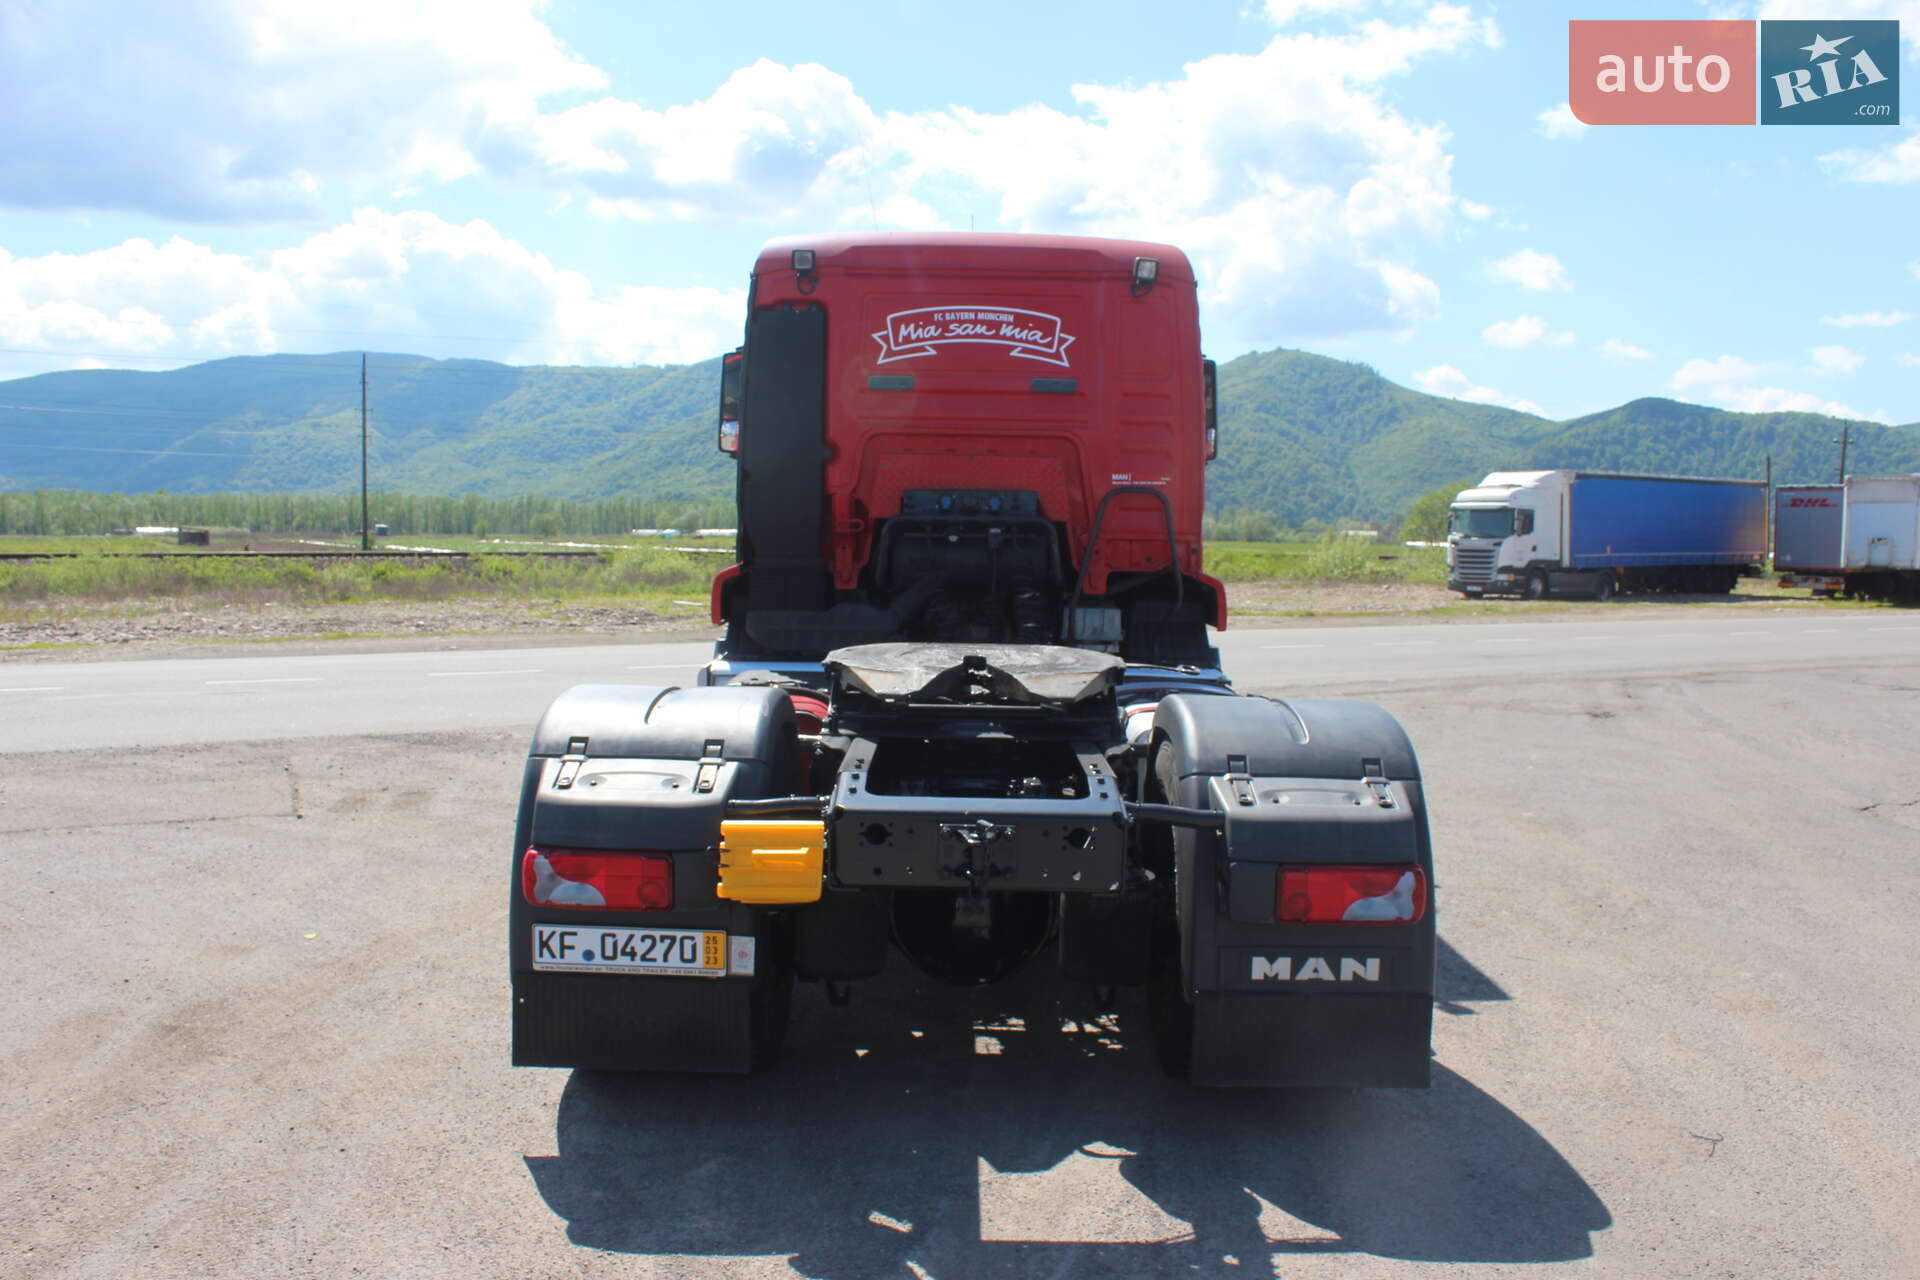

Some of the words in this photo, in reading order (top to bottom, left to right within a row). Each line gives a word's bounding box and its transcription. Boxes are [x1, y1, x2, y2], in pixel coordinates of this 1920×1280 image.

[934, 313, 943, 321] FC
[945, 312, 975, 321] BAYERN
[899, 322, 942, 343] Mia
[944, 322, 996, 336] san
[999, 323, 1053, 344] mia
[1112, 473, 1129, 481] MAN
[1791, 498, 1829, 507] DHL
[538, 930, 578, 960] KF
[601, 932, 697, 964] 04270
[1251, 956, 1380, 981] MAN
